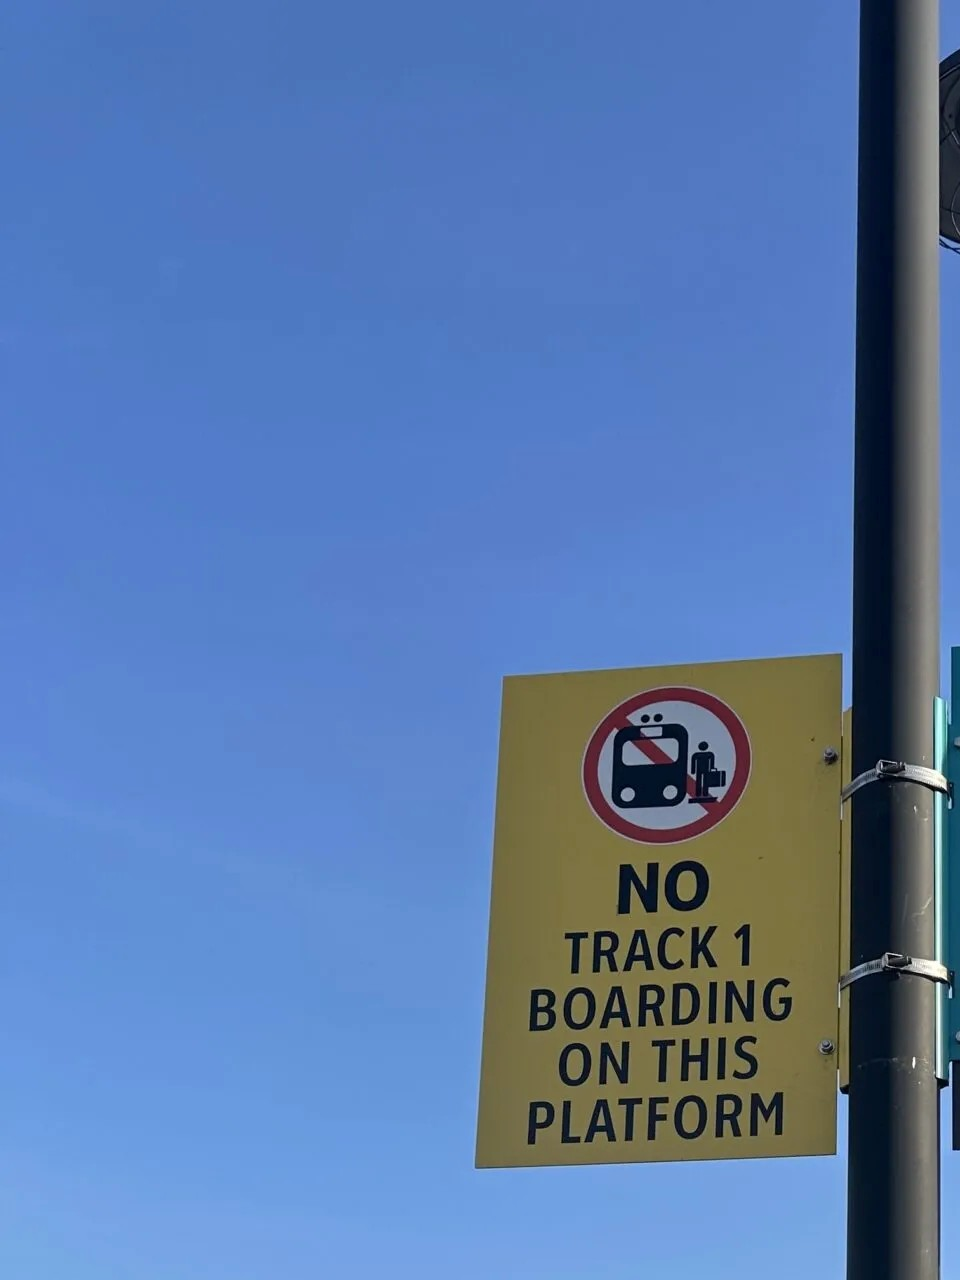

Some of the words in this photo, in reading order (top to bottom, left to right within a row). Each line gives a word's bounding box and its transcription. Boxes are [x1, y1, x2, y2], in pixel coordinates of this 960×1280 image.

[618, 861, 709, 914] NO
[565, 926, 717, 974] TRACK
[734, 924, 750, 966] 1
[529, 978, 792, 1031] BOARDING
[559, 1041, 629, 1086] ON
[652, 1036, 758, 1082] THIS
[528, 1092, 783, 1145] PLATFORM
